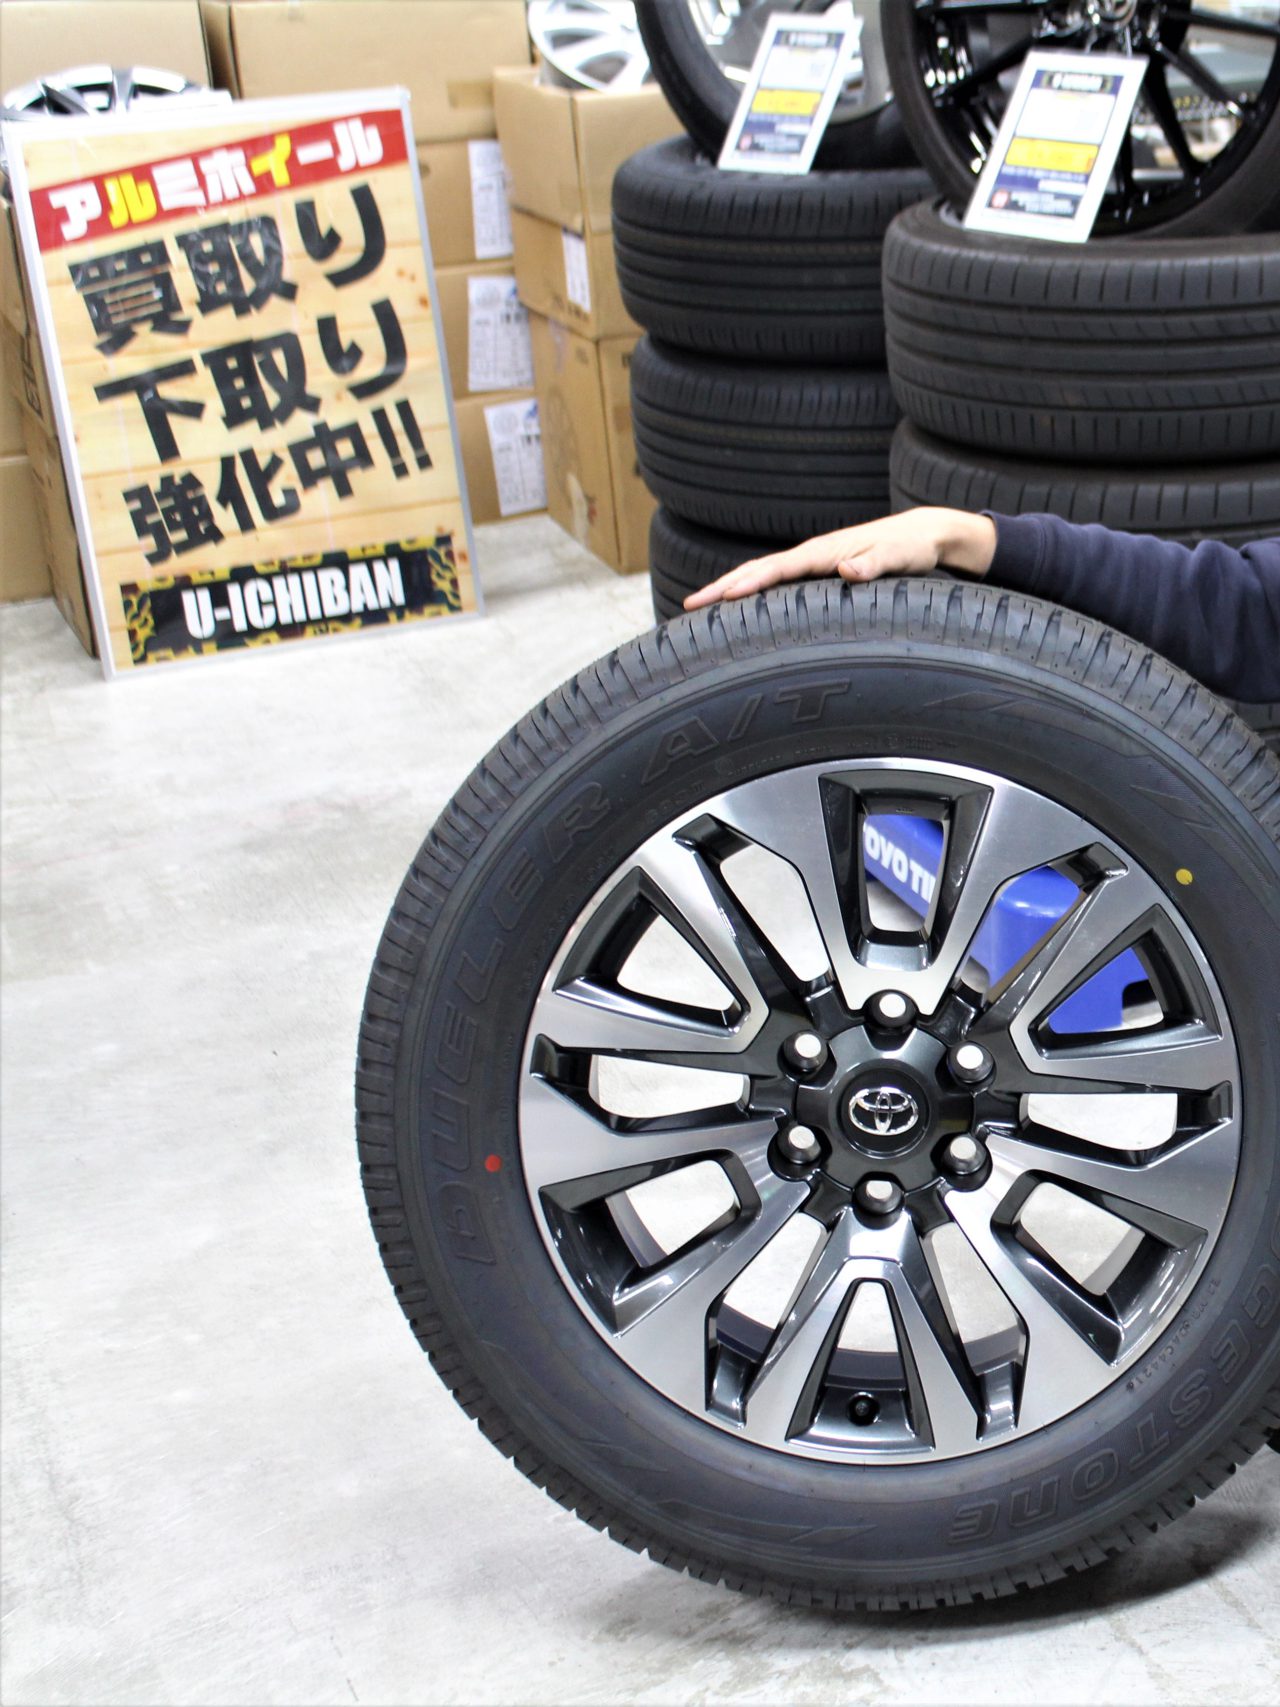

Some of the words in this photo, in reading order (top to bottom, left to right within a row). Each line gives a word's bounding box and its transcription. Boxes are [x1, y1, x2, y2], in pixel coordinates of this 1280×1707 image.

[48, 117, 385, 242] アルミホイール
[67, 182, 387, 356] 買取り
[94, 298, 409, 464] 下取り
[122, 398, 433, 567] 強化中!!
[180, 557, 406, 640] U-ICHIBAN
[863, 822, 909, 884] OYO
[431, 780, 612, 1266] DUELER
[641, 678, 853, 785] A/T
